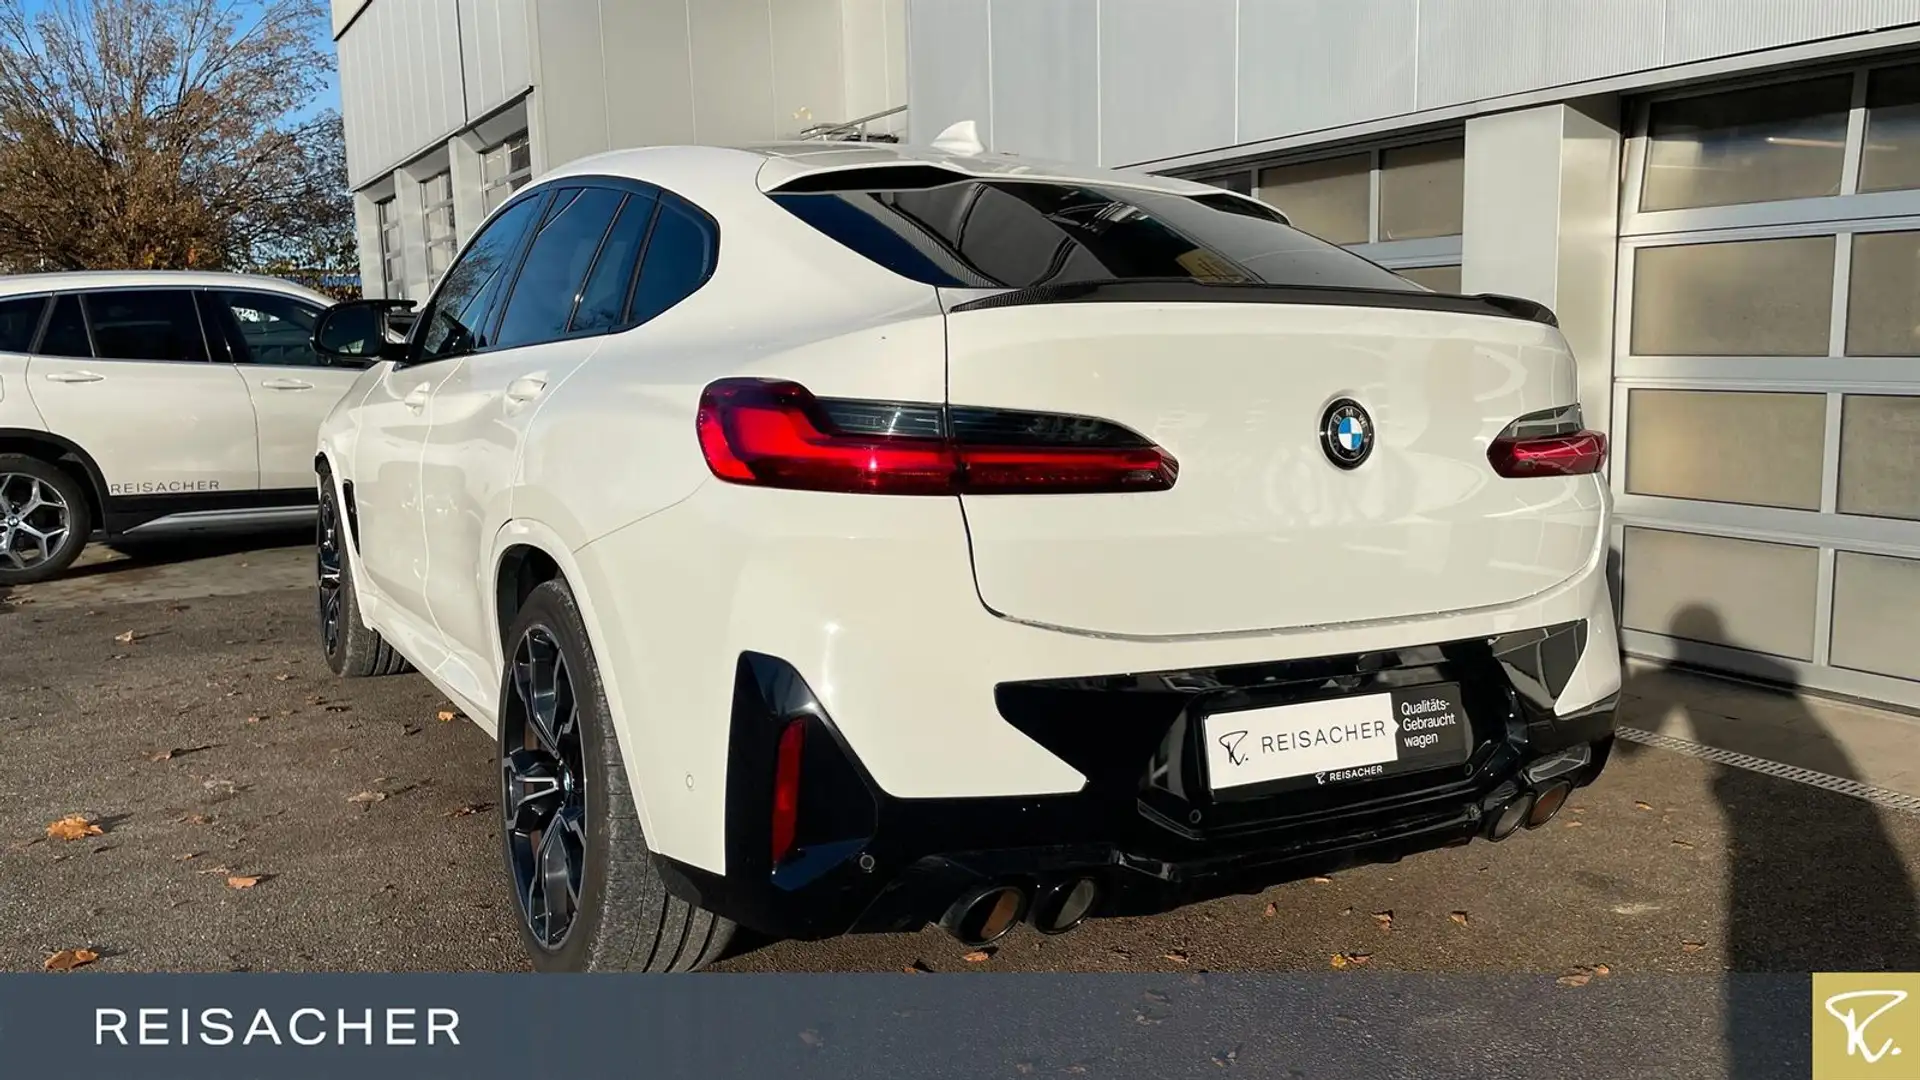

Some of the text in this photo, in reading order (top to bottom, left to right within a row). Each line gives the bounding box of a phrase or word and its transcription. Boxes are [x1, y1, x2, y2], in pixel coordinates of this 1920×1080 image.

[1333, 408, 1368, 428] BMW
[110, 480, 220, 494] REISACHER
[1401, 698, 1450, 716] Qualitäts-
[1402, 712, 1456, 732] Gebraucht
[1261, 720, 1386, 754] REISACHER
[1404, 731, 1439, 749] wagen
[1329, 765, 1383, 782] REISACHER
